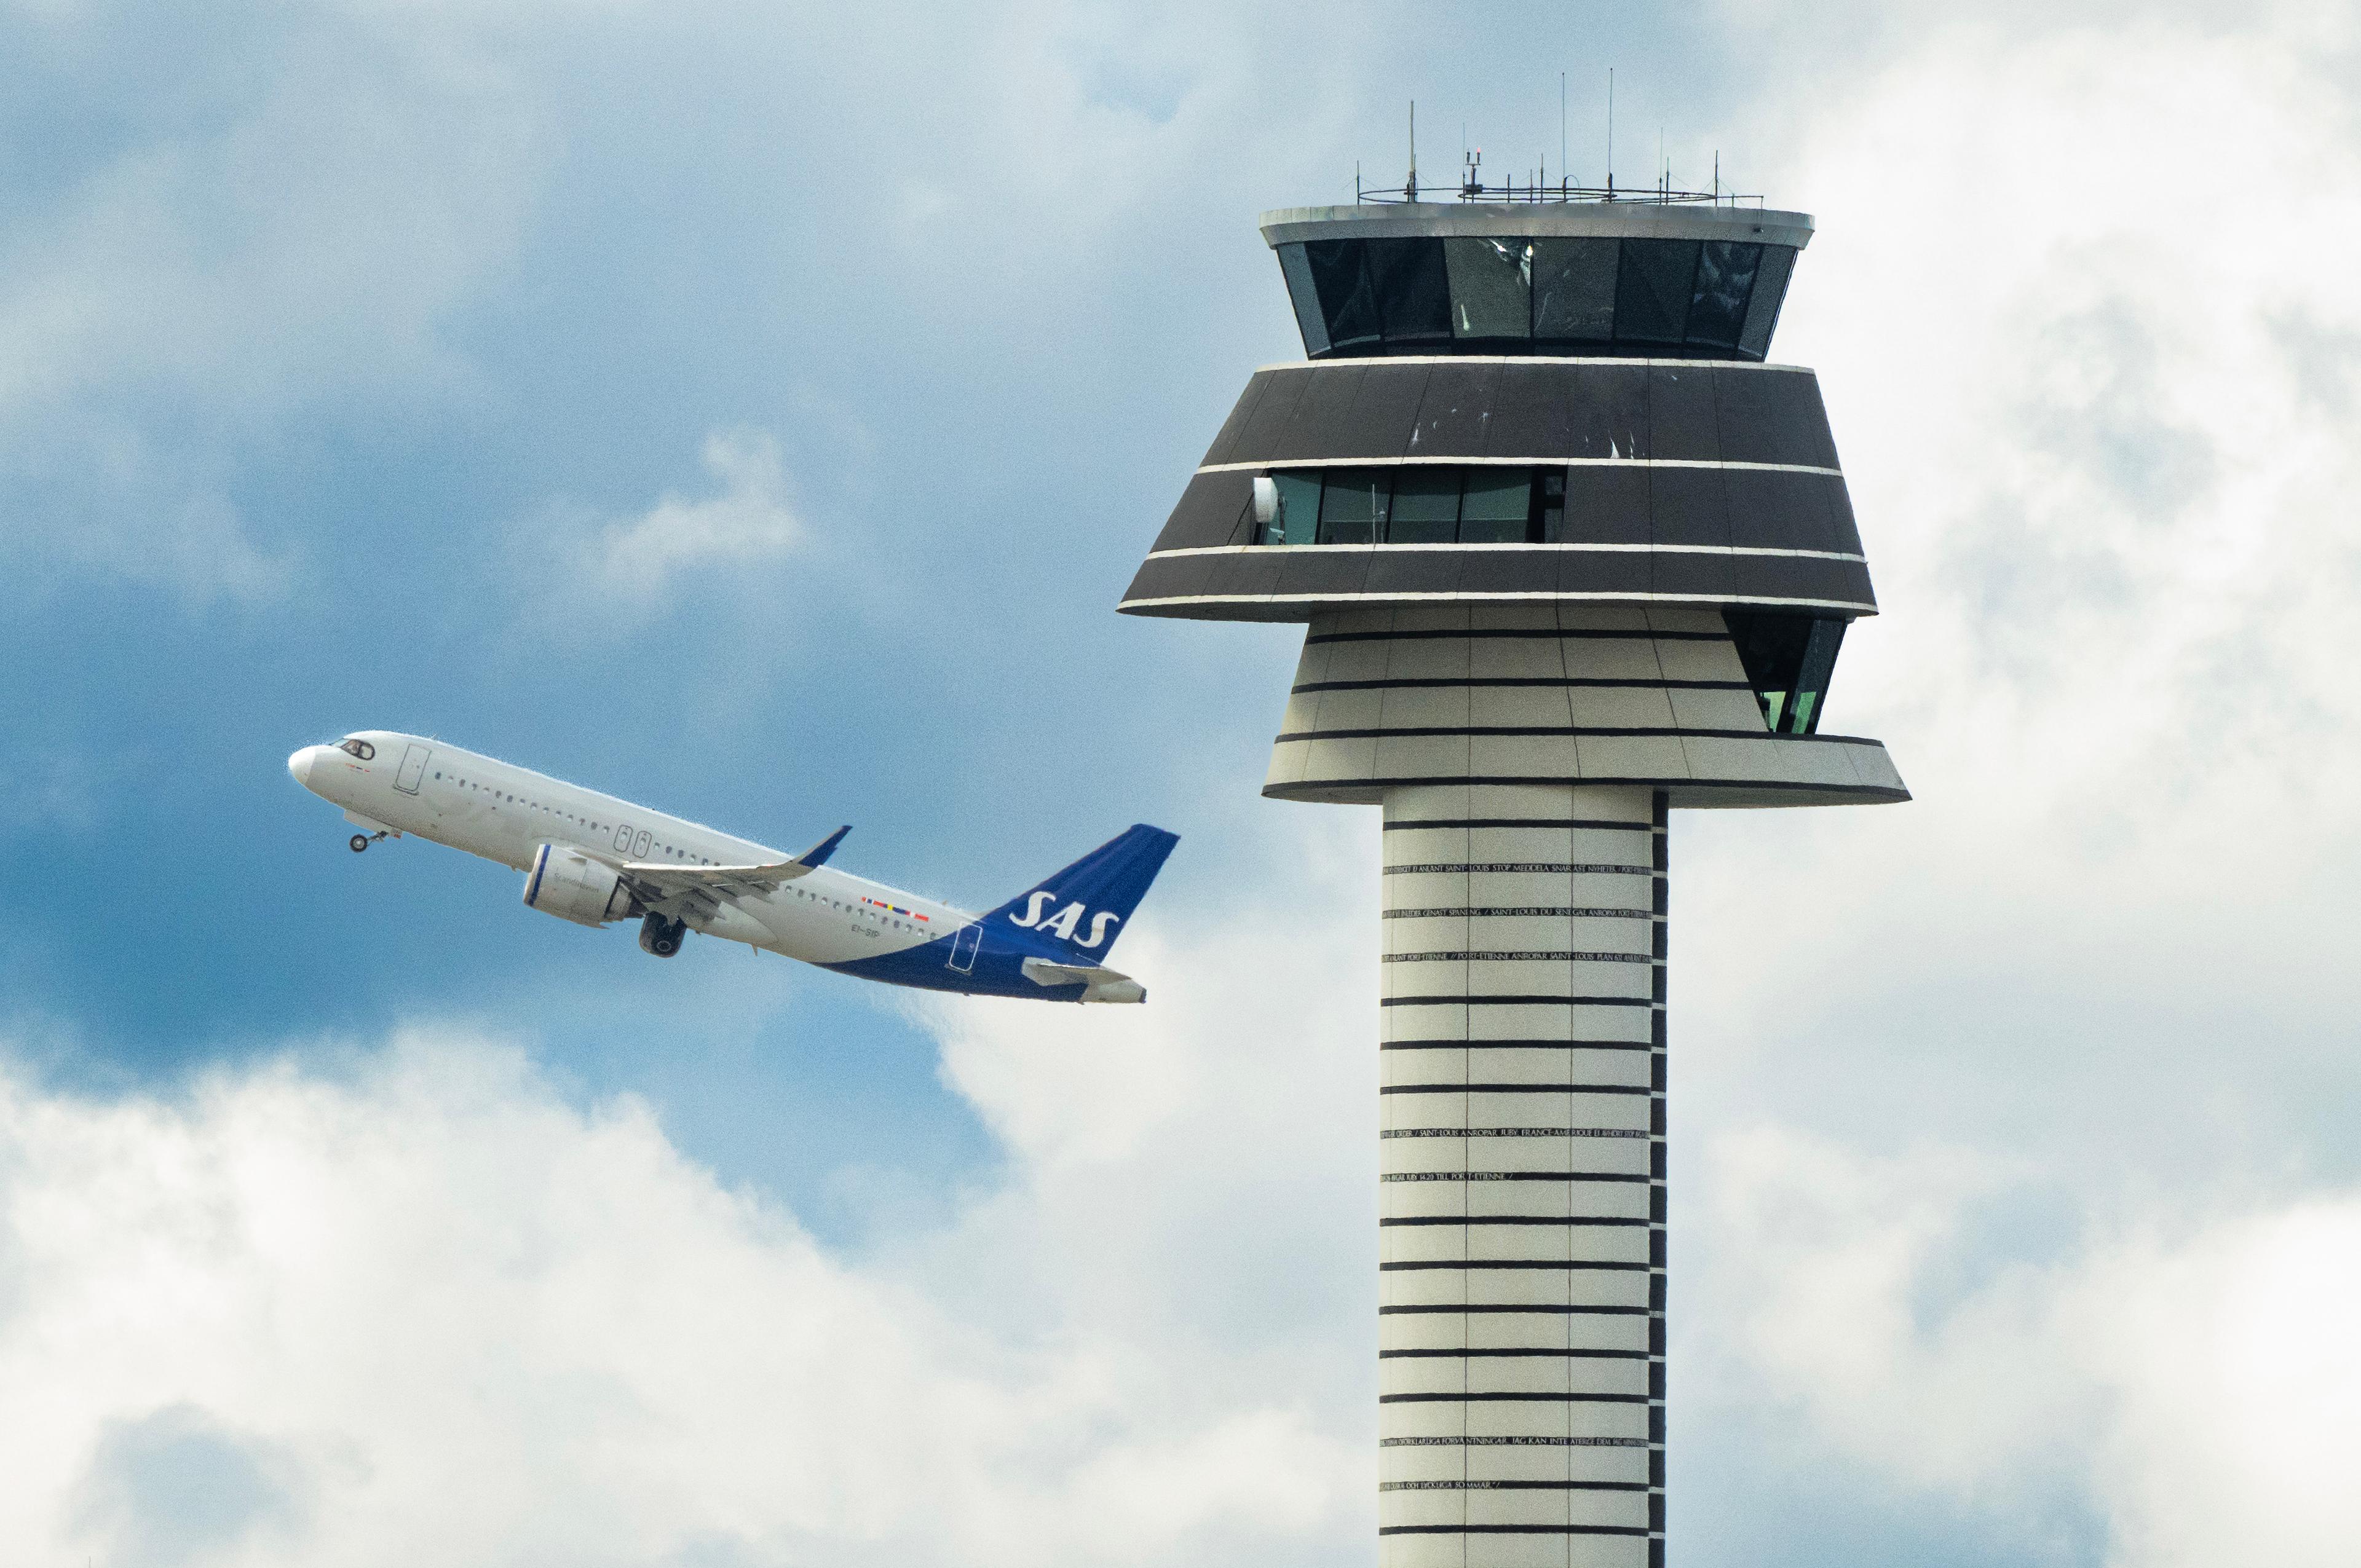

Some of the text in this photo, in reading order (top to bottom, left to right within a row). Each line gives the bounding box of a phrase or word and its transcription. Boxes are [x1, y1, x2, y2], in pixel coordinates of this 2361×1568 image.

[1008, 891, 1120, 948] SAS
[1512, 1436, 1526, 1445] JAG
[1529, 1436, 1548, 1445] KAN
